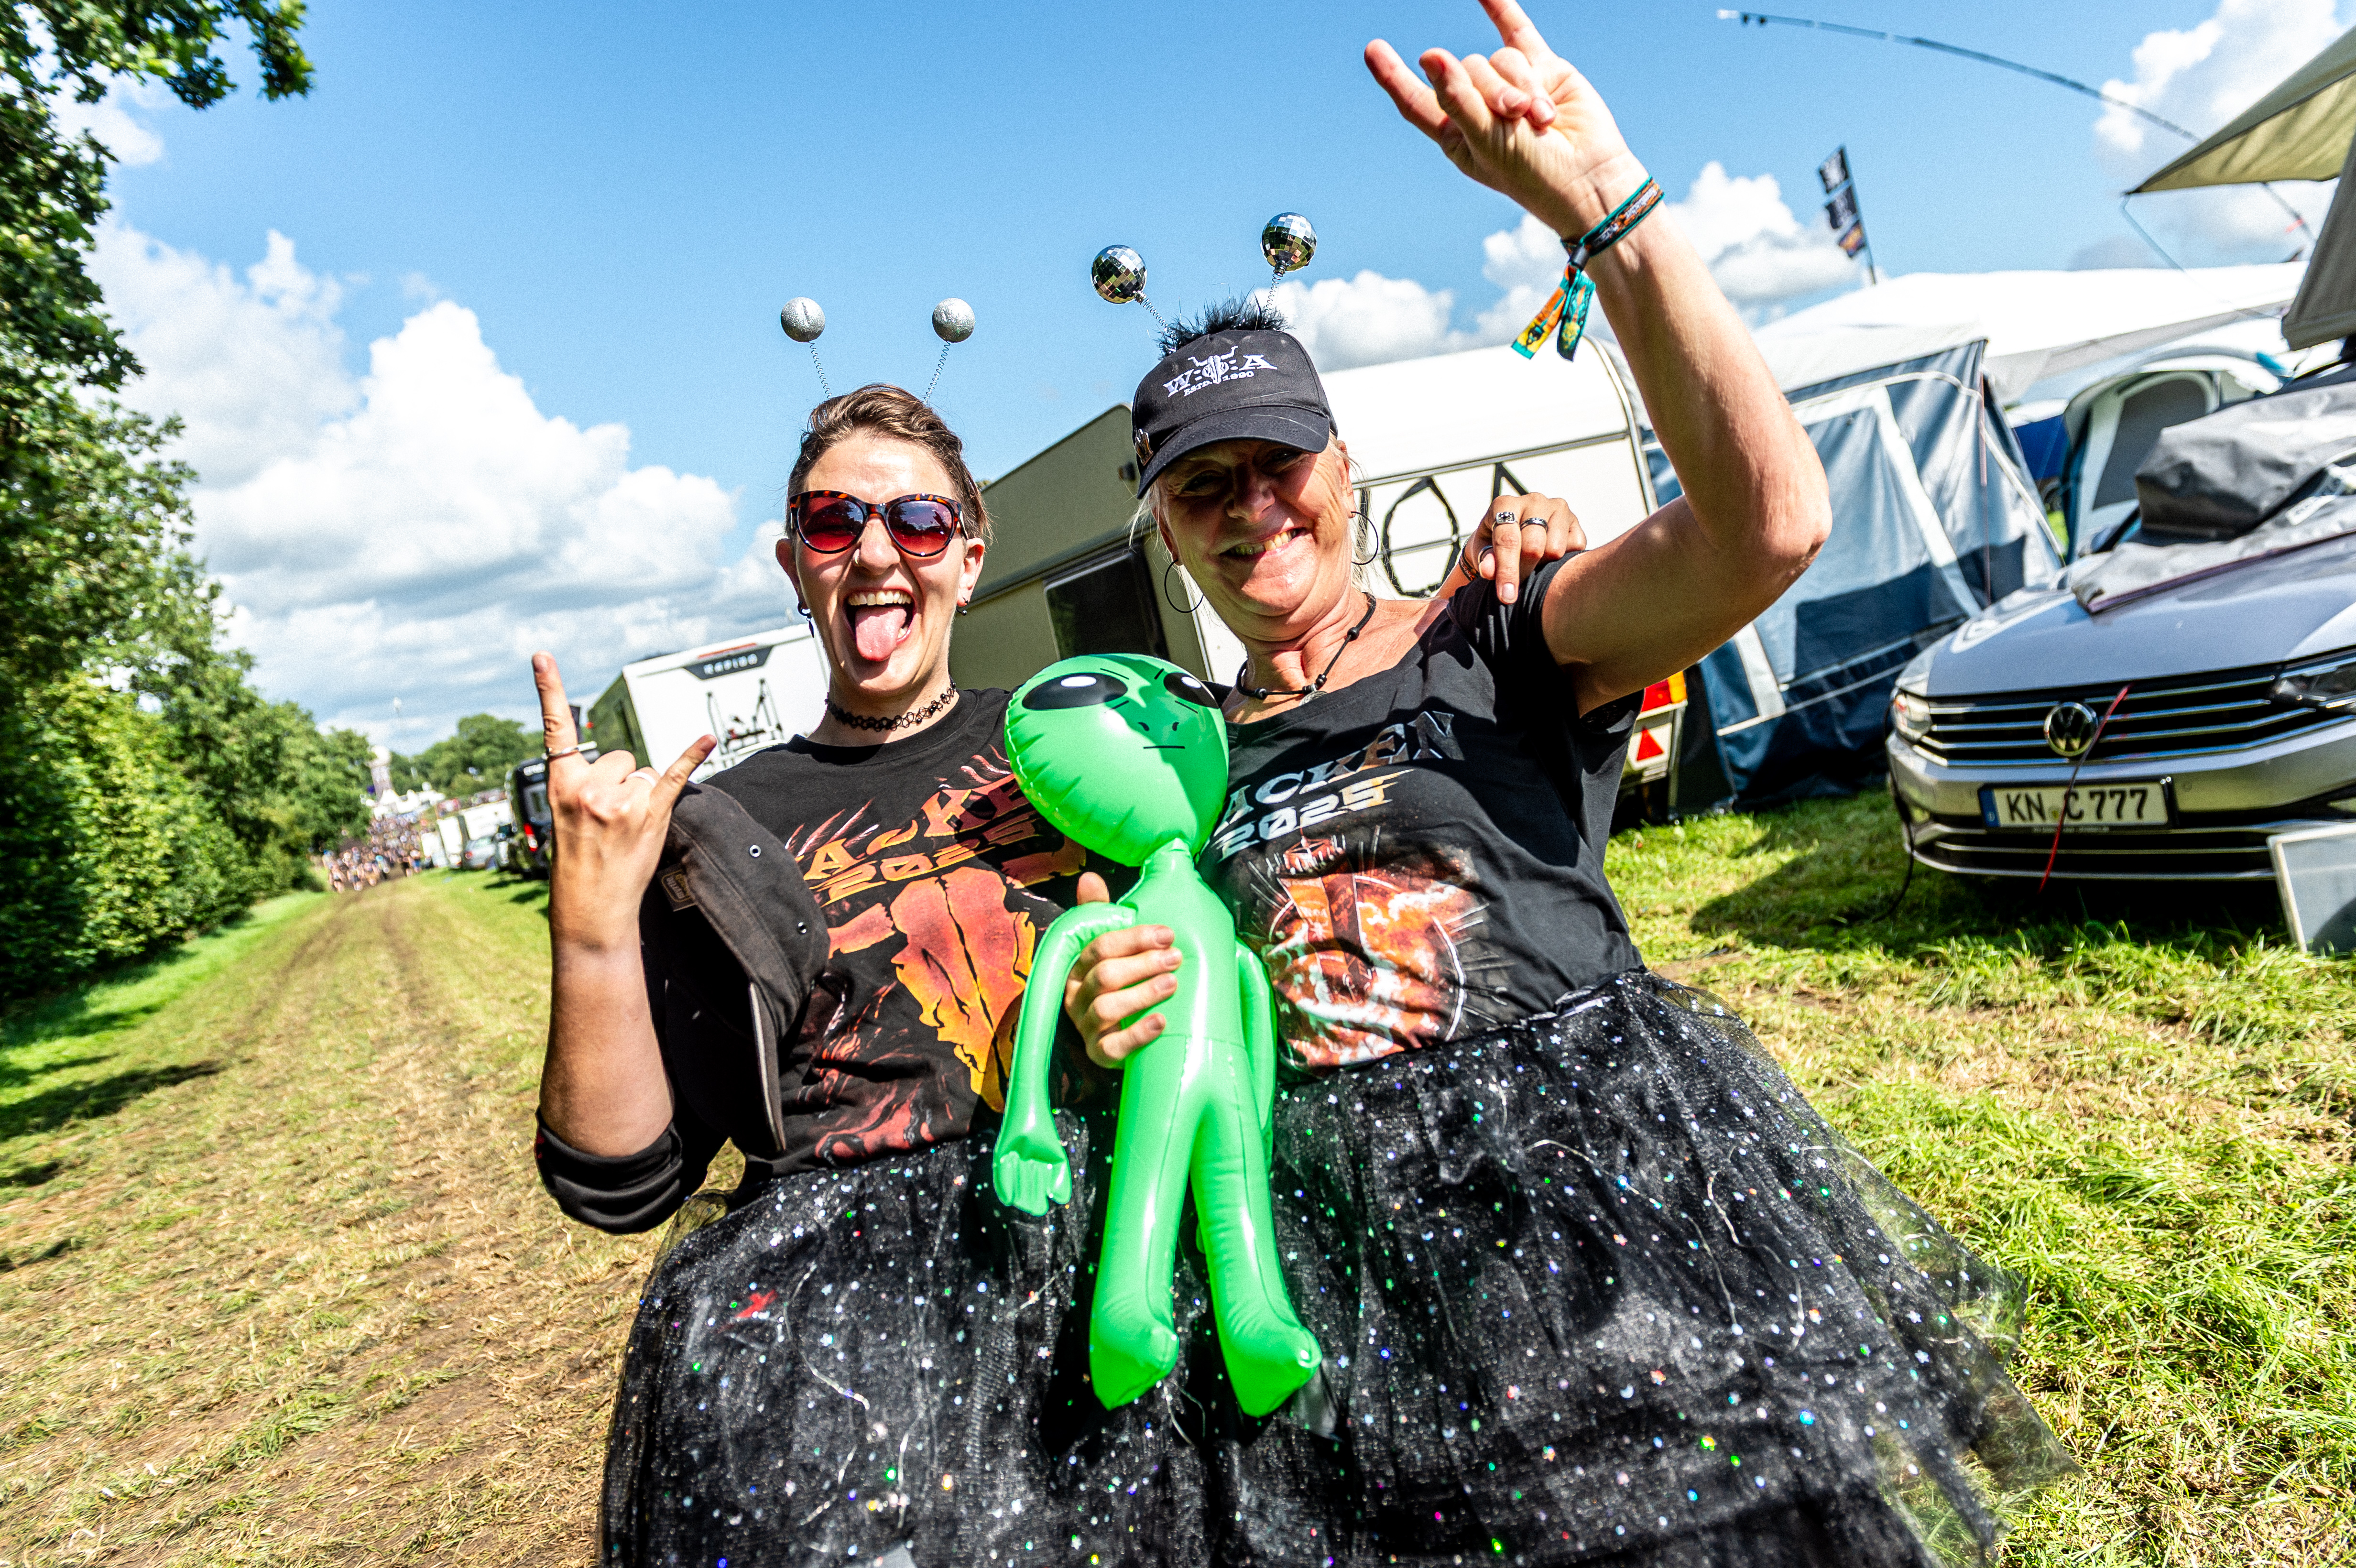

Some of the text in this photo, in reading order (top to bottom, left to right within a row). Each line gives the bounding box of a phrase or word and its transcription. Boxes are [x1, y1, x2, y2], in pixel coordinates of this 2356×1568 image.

[1184, 370, 1254, 397] ESTD. 1990
[1200, 711, 1465, 856] ACKEN
[1211, 768, 1415, 863] 2025
[2007, 791, 2046, 822] KN
[2089, 788, 2149, 819] 777
[808, 809, 1043, 908] 2025
